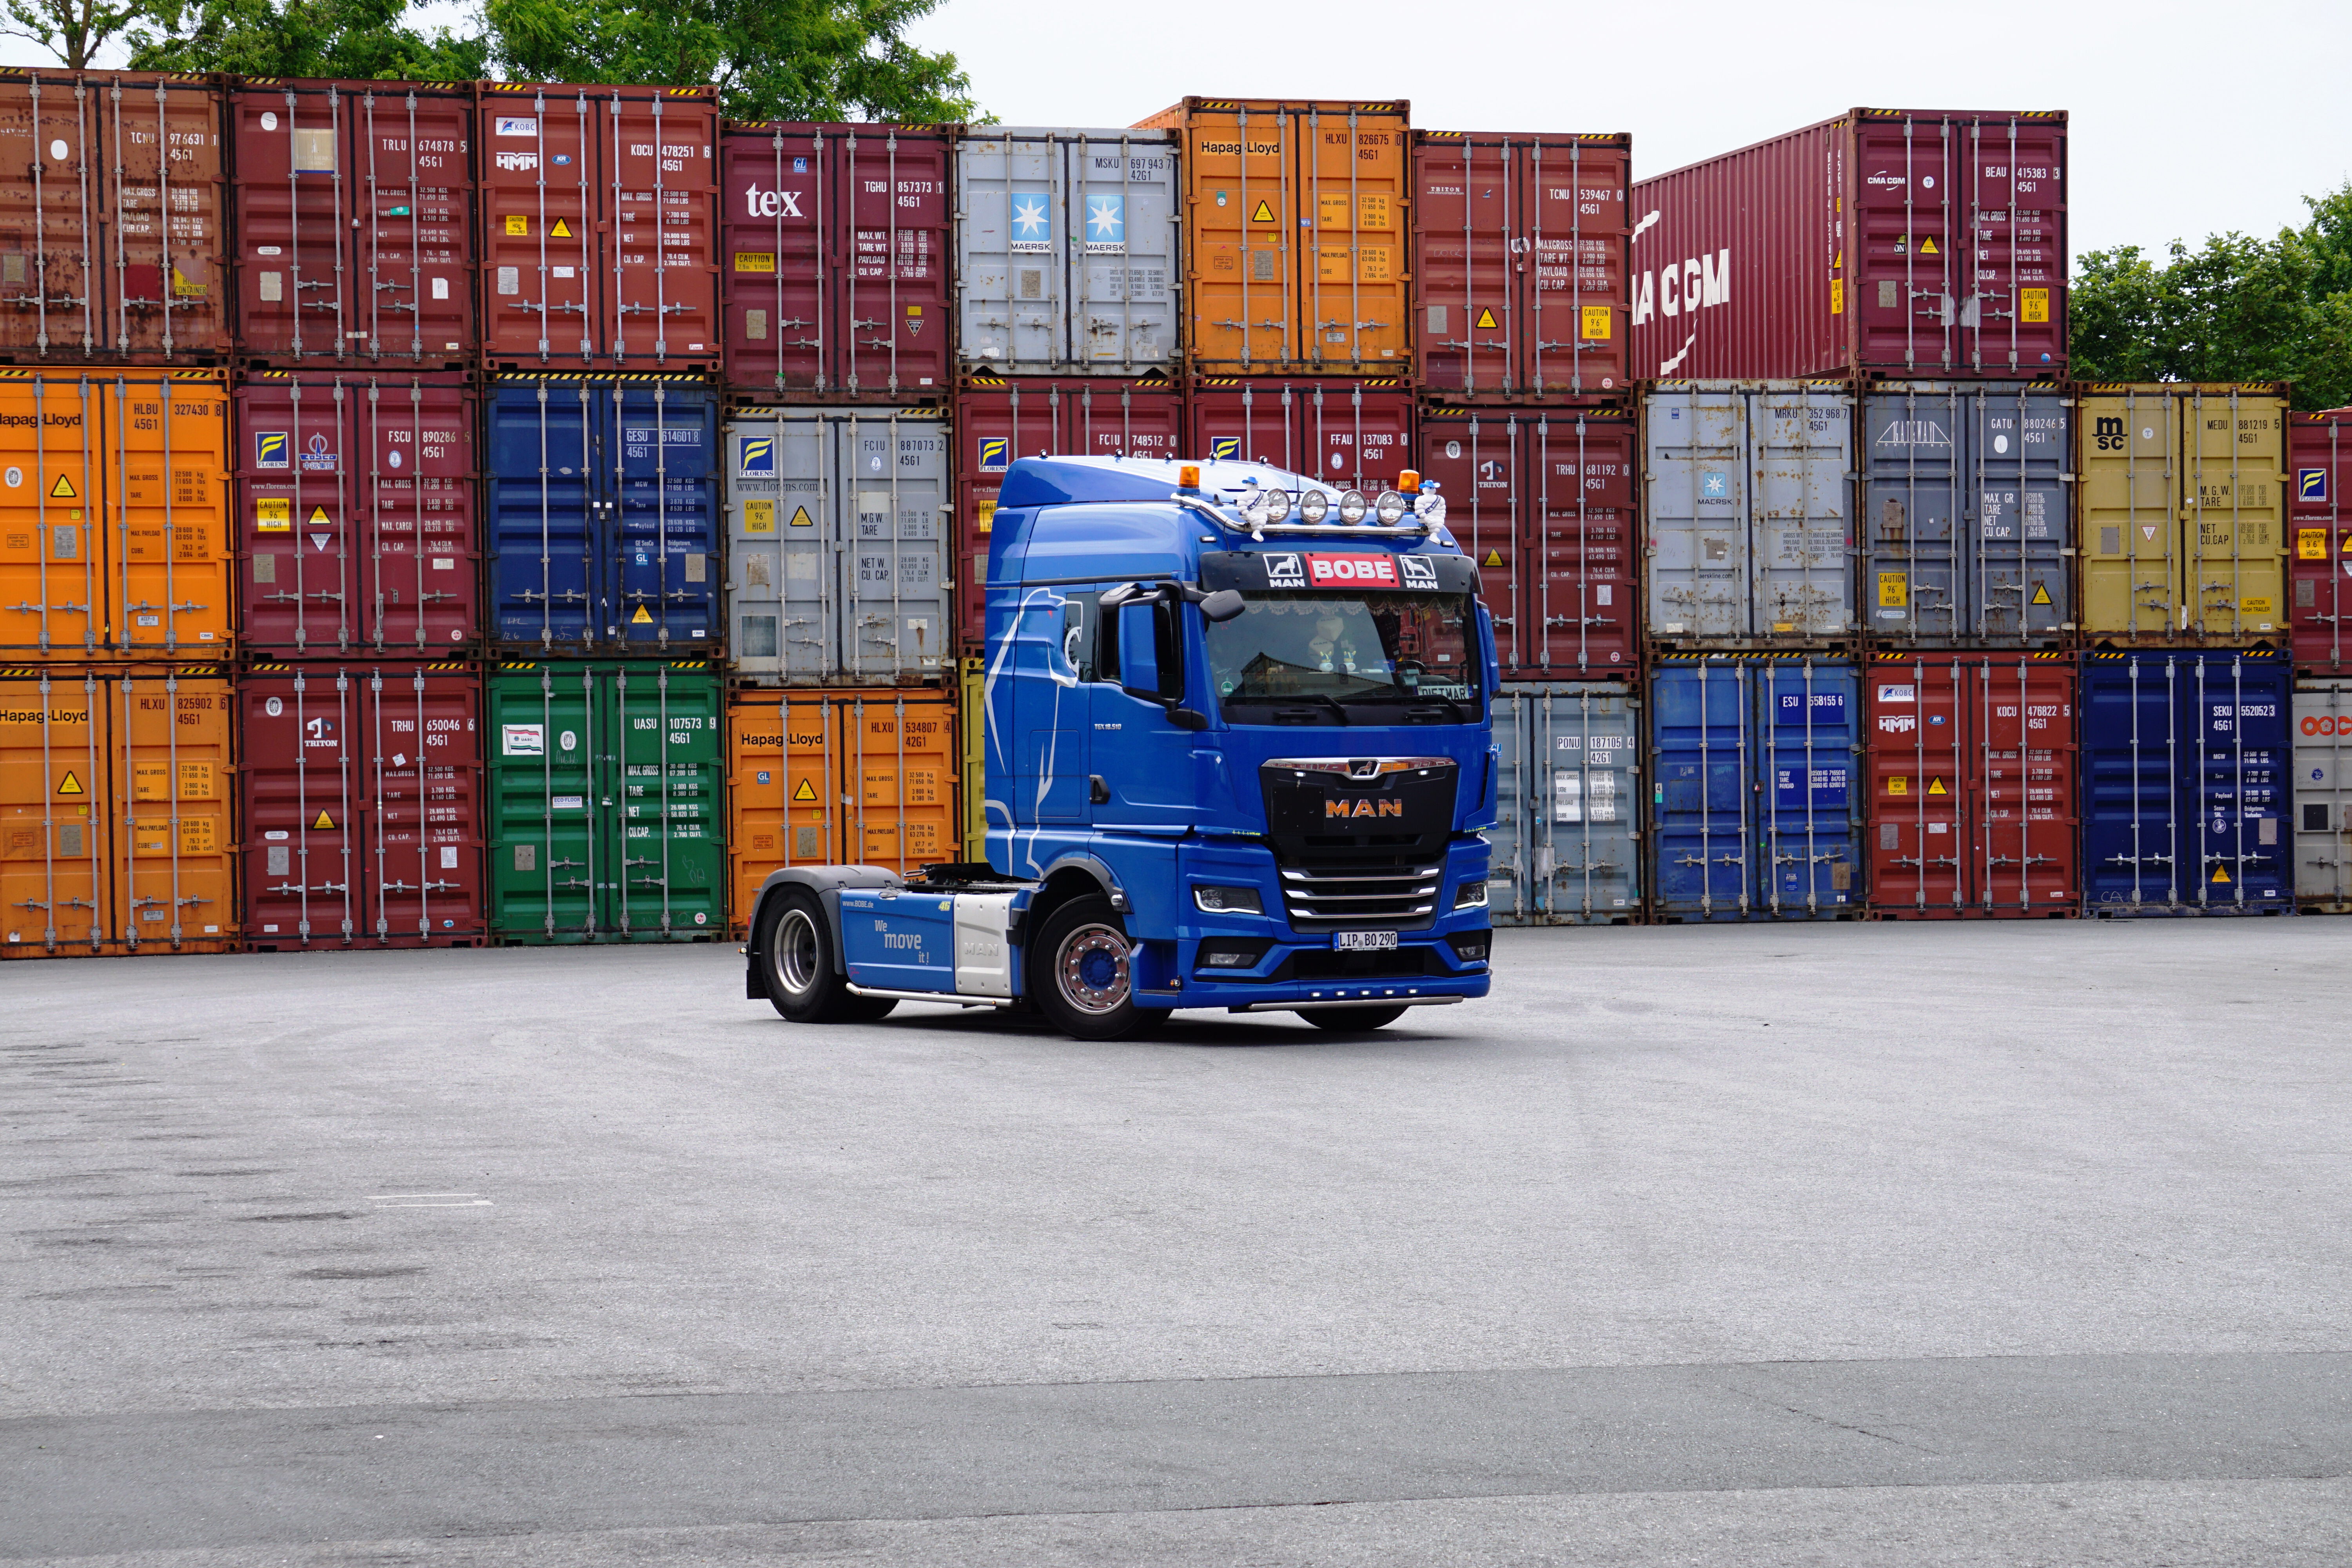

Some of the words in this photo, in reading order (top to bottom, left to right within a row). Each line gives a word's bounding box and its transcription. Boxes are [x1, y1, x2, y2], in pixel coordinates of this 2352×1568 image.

[131, 132, 154, 143] TCNU
[170, 134, 203, 145] 976631
[1326, 134, 1347, 143] HLXU
[1359, 134, 1388, 145] 826675
[383, 140, 406, 150] TRLU
[419, 141, 454, 151] 674878
[631, 145, 653, 155] KOCU
[662, 146, 693, 157] 478251
[171, 150, 192, 160] 45G1
[496, 152, 537, 171] HMM
[1096, 158, 1119, 168] MSKU
[1131, 159, 1145, 169] 697
[1148, 159, 1163, 169] 943
[1131, 171, 1151, 180] 42G1
[1985, 167, 2006, 177] BEAU
[2018, 168, 2046, 178] 415383
[864, 182, 886, 192] TGHU
[898, 182, 931, 192] 857373
[746, 183, 802, 217] tex
[1550, 189, 1569, 199] TCNU
[1581, 190, 1610, 200] 539467
[1662, 249, 1729, 317] CGM
[134, 404, 158, 414] HLBU
[175, 405, 208, 415] 327430
[1775, 409, 1797, 419] MRKU
[1809, 409, 1824, 419] 352
[1826, 409, 1840, 419] 968
[0, 414, 81, 427] apagLloyd
[1992, 419, 2012, 428] GATU
[2025, 419, 2056, 428] 880246
[2208, 420, 2227, 430] MEDU
[2239, 420, 2267, 430] 881219
[388, 431, 410, 442] FSCU
[423, 432, 456, 442] 890286
[627, 431, 648, 441] GESU
[662, 431, 691, 442] 614601
[1099, 435, 1120, 445] FCIU
[1132, 436, 1163, 446] 748512
[1331, 435, 1352, 445] FFAU
[1363, 435, 1392, 445] 137083
[2025, 433, 2045, 443] 45G1
[864, 441, 885, 450] FCIU
[901, 441, 933, 450] 887073
[1363, 450, 1383, 459] 45G1
[302, 461, 334, 470] 中远集团
[1556, 465, 1575, 475] TRHU
[1586, 465, 1615, 475] 681192
[737, 481, 818, 491] www.florens.com
[1985, 494, 2001, 503] MAX.
[2005, 494, 2015, 503] GR.
[2201, 497, 2221, 506] TARE
[1312, 560, 1394, 579] BOBE
[1270, 579, 1305, 588] MAN
[1406, 580, 1438, 589] MAN
[1423, 688, 1466, 699] DIETMAR
[141, 699, 165, 710] HLXU
[178, 699, 212, 709] 825902
[1810, 696, 1835, 706] 558155
[1997, 706, 2016, 717] KOCU
[2028, 706, 2056, 716] 476822
[2214, 706, 2232, 717] SEKU
[2241, 706, 2268, 716] 552052
[392, 721, 414, 731] TRHU
[427, 720, 459, 731] 650046
[634, 719, 657, 729] UASU
[670, 718, 701, 730] 107573
[871, 722, 893, 732] HLXU
[906, 723, 936, 732] 534807
[1879, 715, 1915, 733] HMM
[2300, 716, 2352, 736] OOC
[742, 734, 822, 747] HapagLloyd
[1558, 738, 1580, 748] PONU
[1592, 738, 1621, 748] 187105
[1591, 753, 1610, 763] 42G1
[1326, 799, 1402, 818] MAN
[938, 901, 951, 911] 46
[875, 920, 887, 931] We
[884, 933, 921, 949] move
[1340, 934, 1357, 946] LIP
[1365, 933, 1376, 946] BO
[1379, 933, 1396, 946] 290
[964, 942, 998, 956] MAN
